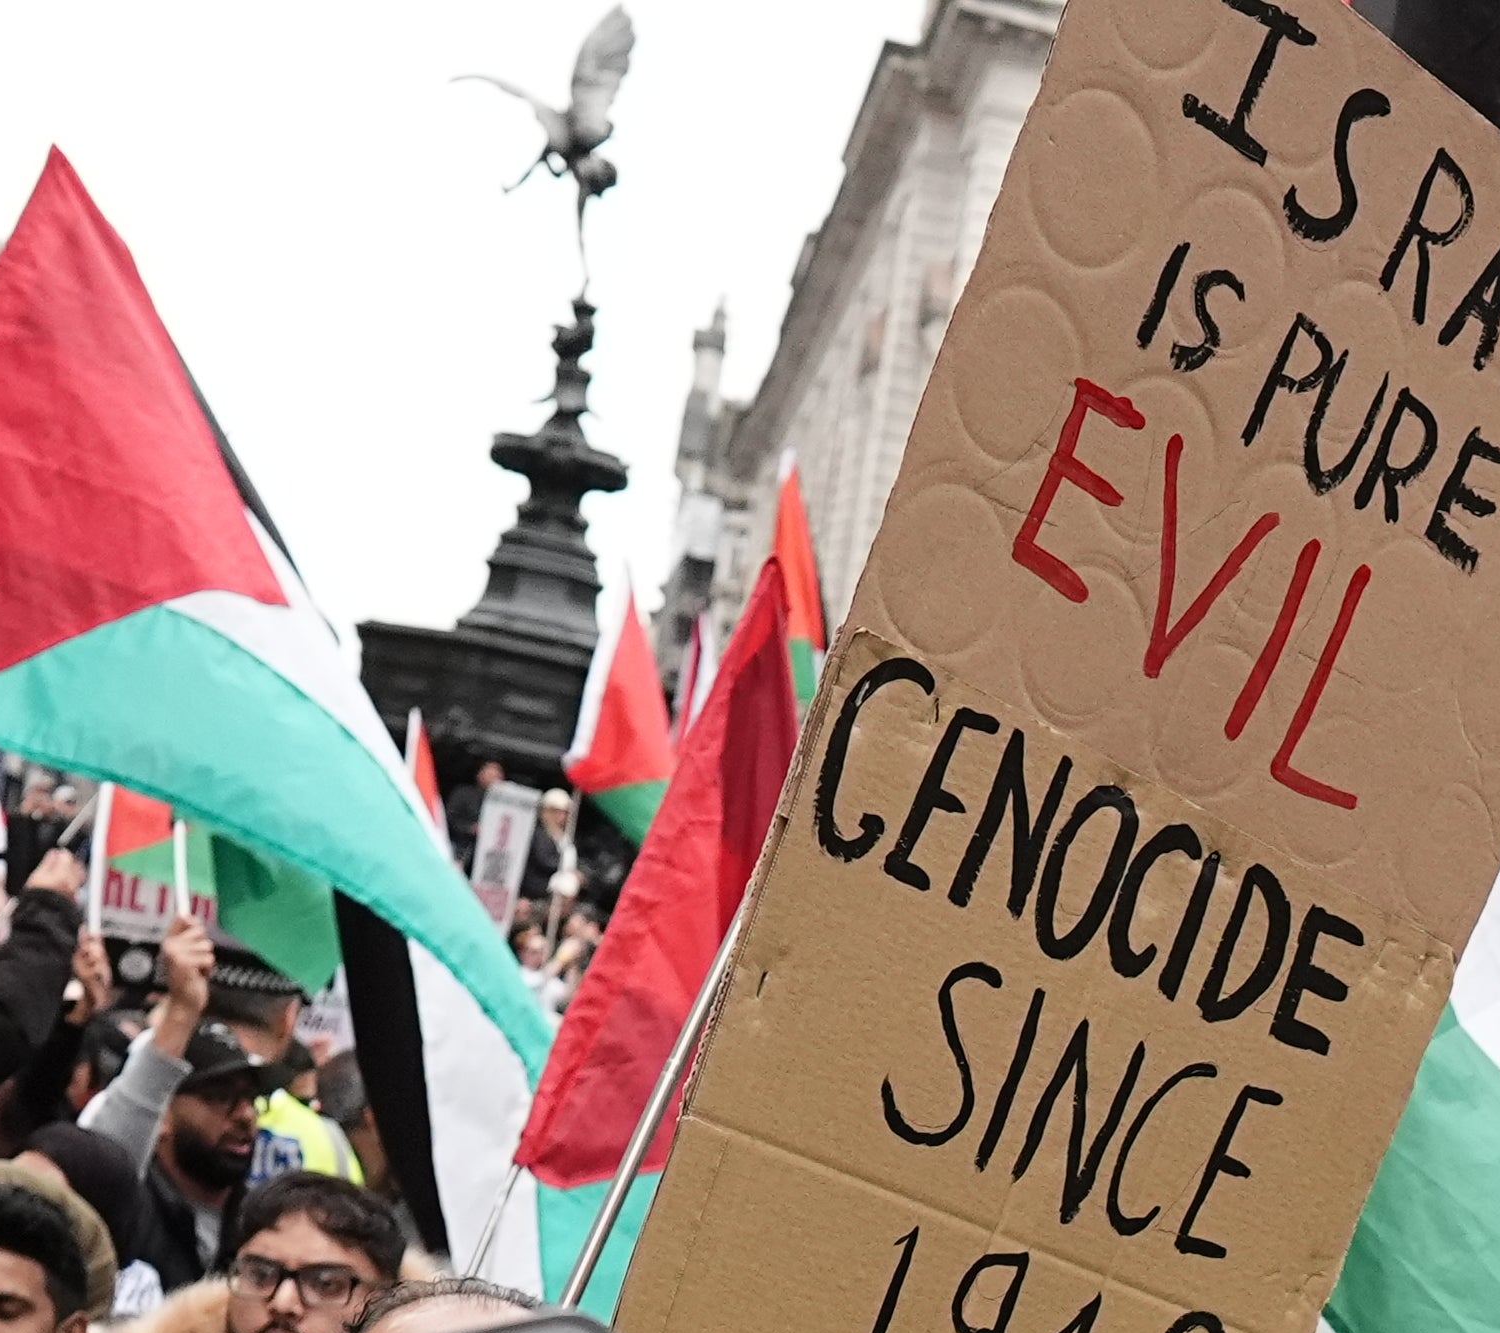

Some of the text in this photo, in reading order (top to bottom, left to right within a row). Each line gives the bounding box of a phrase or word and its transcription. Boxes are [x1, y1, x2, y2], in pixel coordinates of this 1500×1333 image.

[1137, 242, 1245, 372] IS
[1012, 377, 1372, 809] EVIL
[814, 656, 1364, 1056] GENOCIDE
[882, 961, 1283, 1259] SINCE
